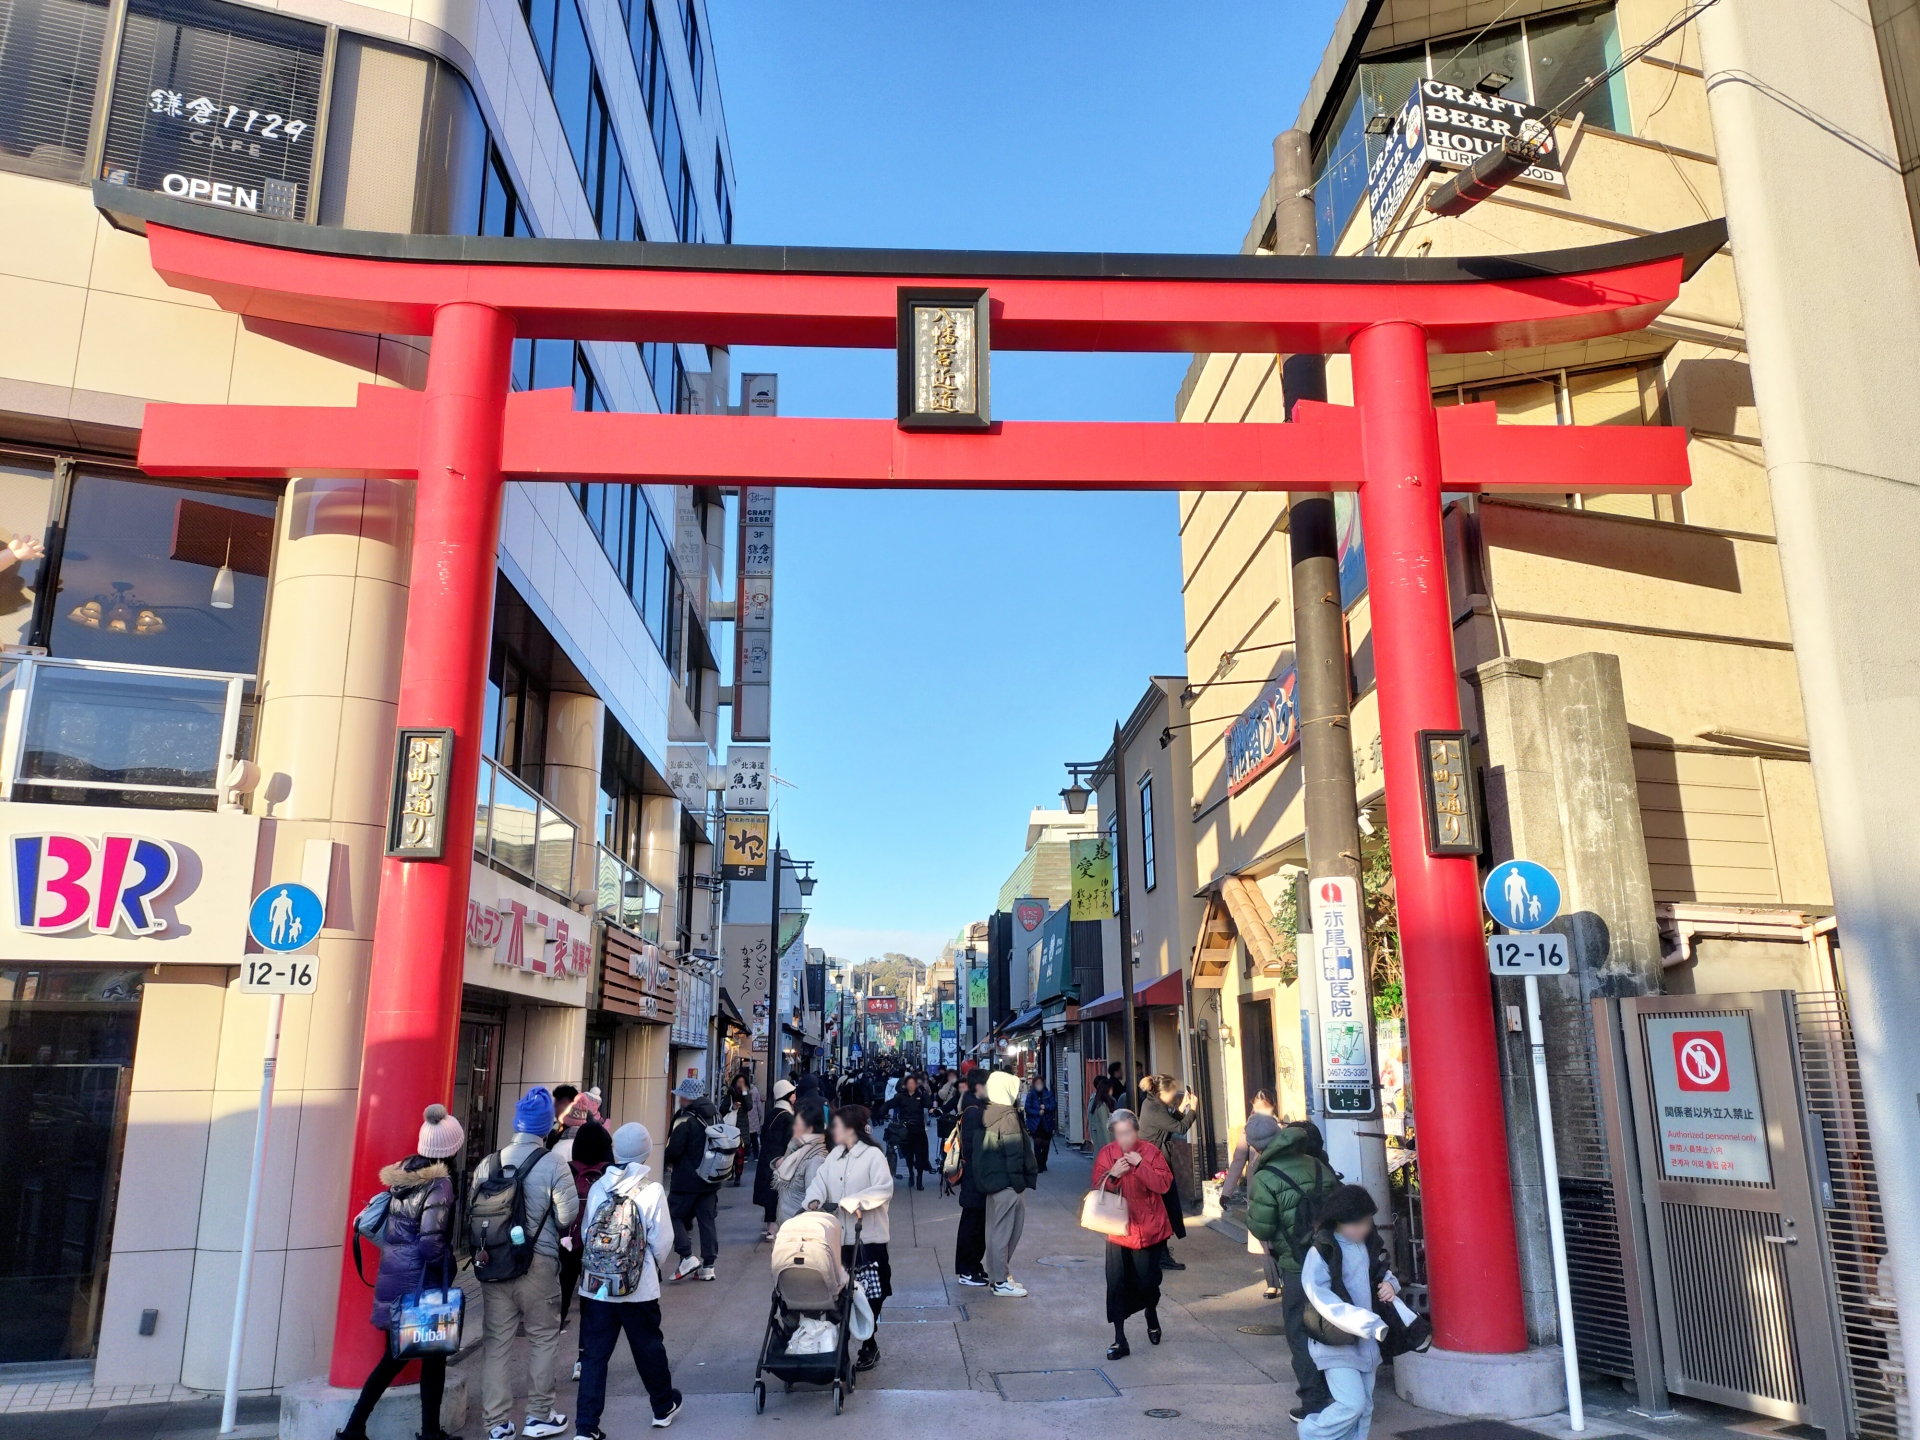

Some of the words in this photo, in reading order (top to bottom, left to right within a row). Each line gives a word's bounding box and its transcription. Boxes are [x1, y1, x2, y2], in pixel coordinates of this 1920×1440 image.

[149, 88, 307, 142] 鎌倉1129
[1423, 80, 1526, 118] CRAFT
[1426, 105, 1515, 137] BEER
[189, 131, 261, 157] CAFE
[1368, 99, 1410, 186] CRAFT
[1428, 129, 1501, 155] HOU
[162, 173, 258, 212] OPEN
[1371, 143, 1405, 211] BEER
[1373, 153, 1414, 231] HOUSE
[931, 307, 959, 413] 八幡宮近道
[747, 543, 770, 555] 鎌倉
[753, 531, 764, 539] 3F
[747, 555, 770, 564] 1129
[741, 761, 765, 770] 北海道
[403, 739, 440, 844] 小町通り
[738, 797, 755, 805] B1F
[1433, 742, 1467, 843] 小町通り
[728, 829, 764, 861] わん
[14, 834, 172, 930] BR
[738, 866, 755, 877] 5F
[1324, 910, 1346, 946] 赤尾
[571, 938, 592, 975] 洋菓子
[1496, 943, 1563, 967] 12-16
[249, 962, 312, 986] 12-16
[1330, 981, 1353, 1017] 医院
[1340, 1098, 1360, 1107] 1-5
[1664, 1106, 1754, 1120] 関係者以外立入禁止
[1667, 1130, 1704, 1140] Authorized
[1705, 1132, 1740, 1141] personnel
[1741, 1134, 1757, 1143] only
[412, 1327, 447, 1343] Dubai
